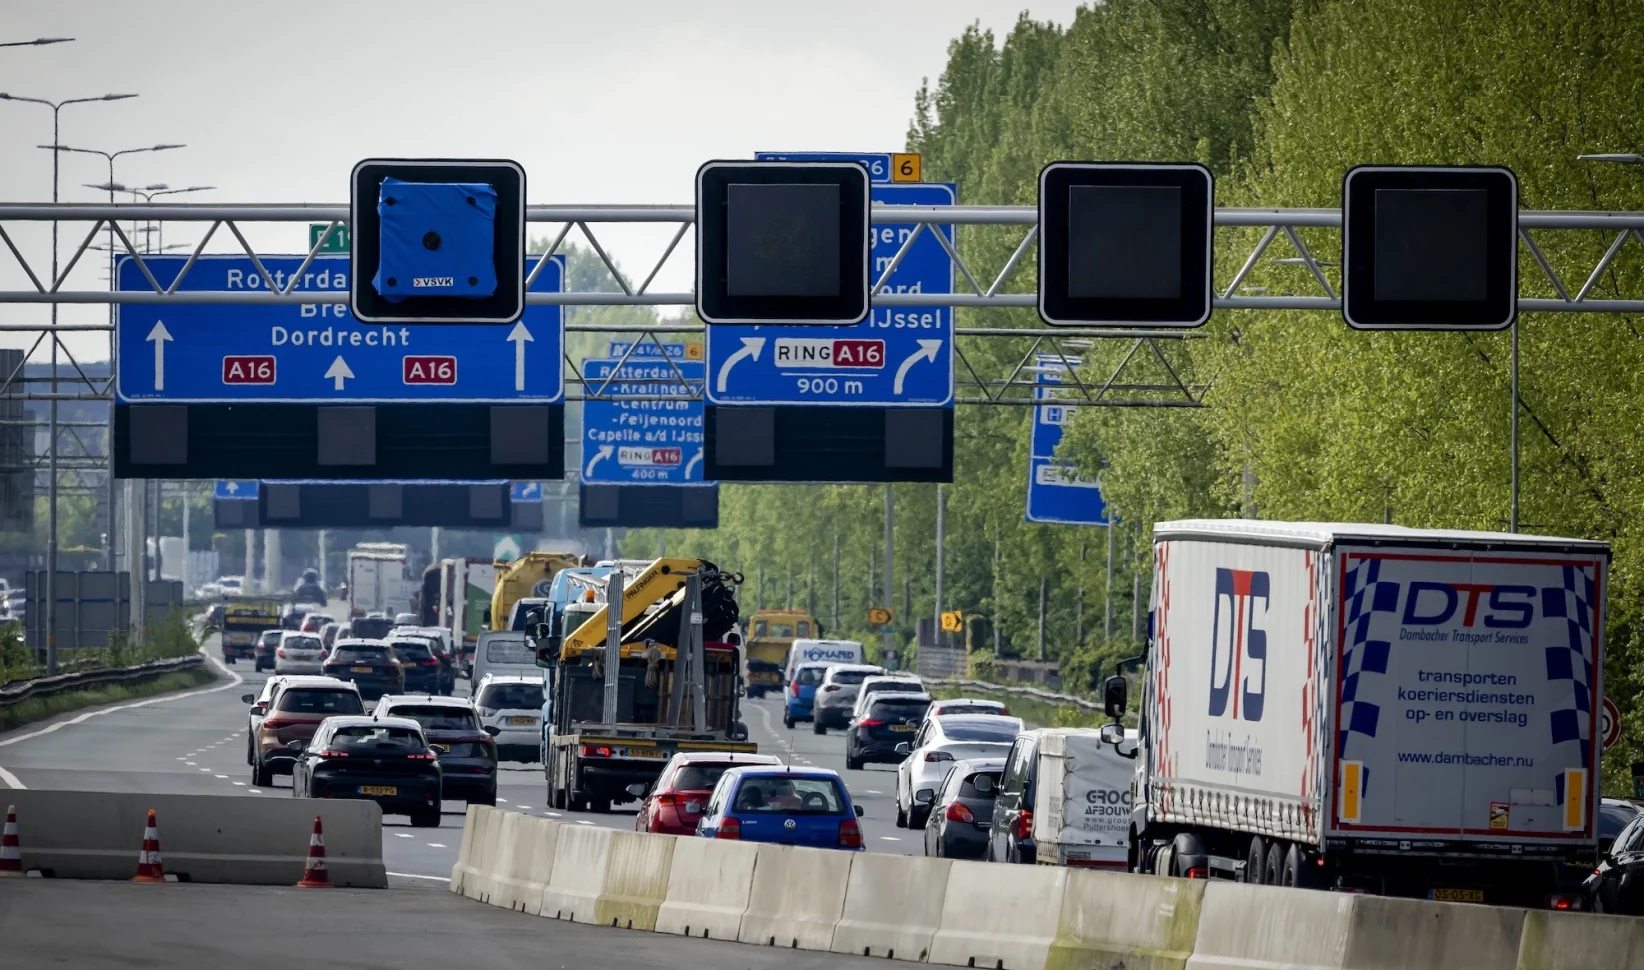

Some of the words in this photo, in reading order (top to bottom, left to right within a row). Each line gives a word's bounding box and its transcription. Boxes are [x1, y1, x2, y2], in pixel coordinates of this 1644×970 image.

[900, 160, 913, 176] 6
[338, 230, 350, 247] 1
[227, 269, 347, 289] Rotterda
[423, 278, 452, 286] VSVK
[300, 303, 349, 317] Bre
[870, 309, 941, 329] IJssel
[271, 326, 410, 346] Dordrecht
[778, 345, 831, 361] RING
[837, 345, 880, 362] A16
[228, 361, 271, 379] A16
[409, 361, 452, 380] A16
[600, 366, 683, 378] Rtterdam
[796, 378, 838, 395] 900
[844, 380, 863, 394] m
[588, 428, 640, 442] Capelle
[645, 430, 667, 442] a/d
[672, 430, 703, 442] IJss
[620, 449, 651, 460] RING
[654, 451, 678, 462] A16
[631, 469, 656, 479] 400
[657, 470, 669, 479] m
[626, 569, 659, 600] PALFINGER
[1402, 581, 1537, 628] DTS
[1208, 567, 1270, 722] DTS
[1400, 628, 1449, 642] Dambacher
[1452, 629, 1493, 645] Transport
[1494, 631, 1529, 644] Services
[1418, 670, 1517, 687] transporten
[1398, 686, 1535, 705] koeriersdiensten
[1406, 709, 1431, 723] op-
[1435, 710, 1454, 720] en
[1459, 709, 1528, 727] overslag
[1398, 751, 1534, 767] www.dambacher.nu
[1084, 817, 1130, 825] www.groo
